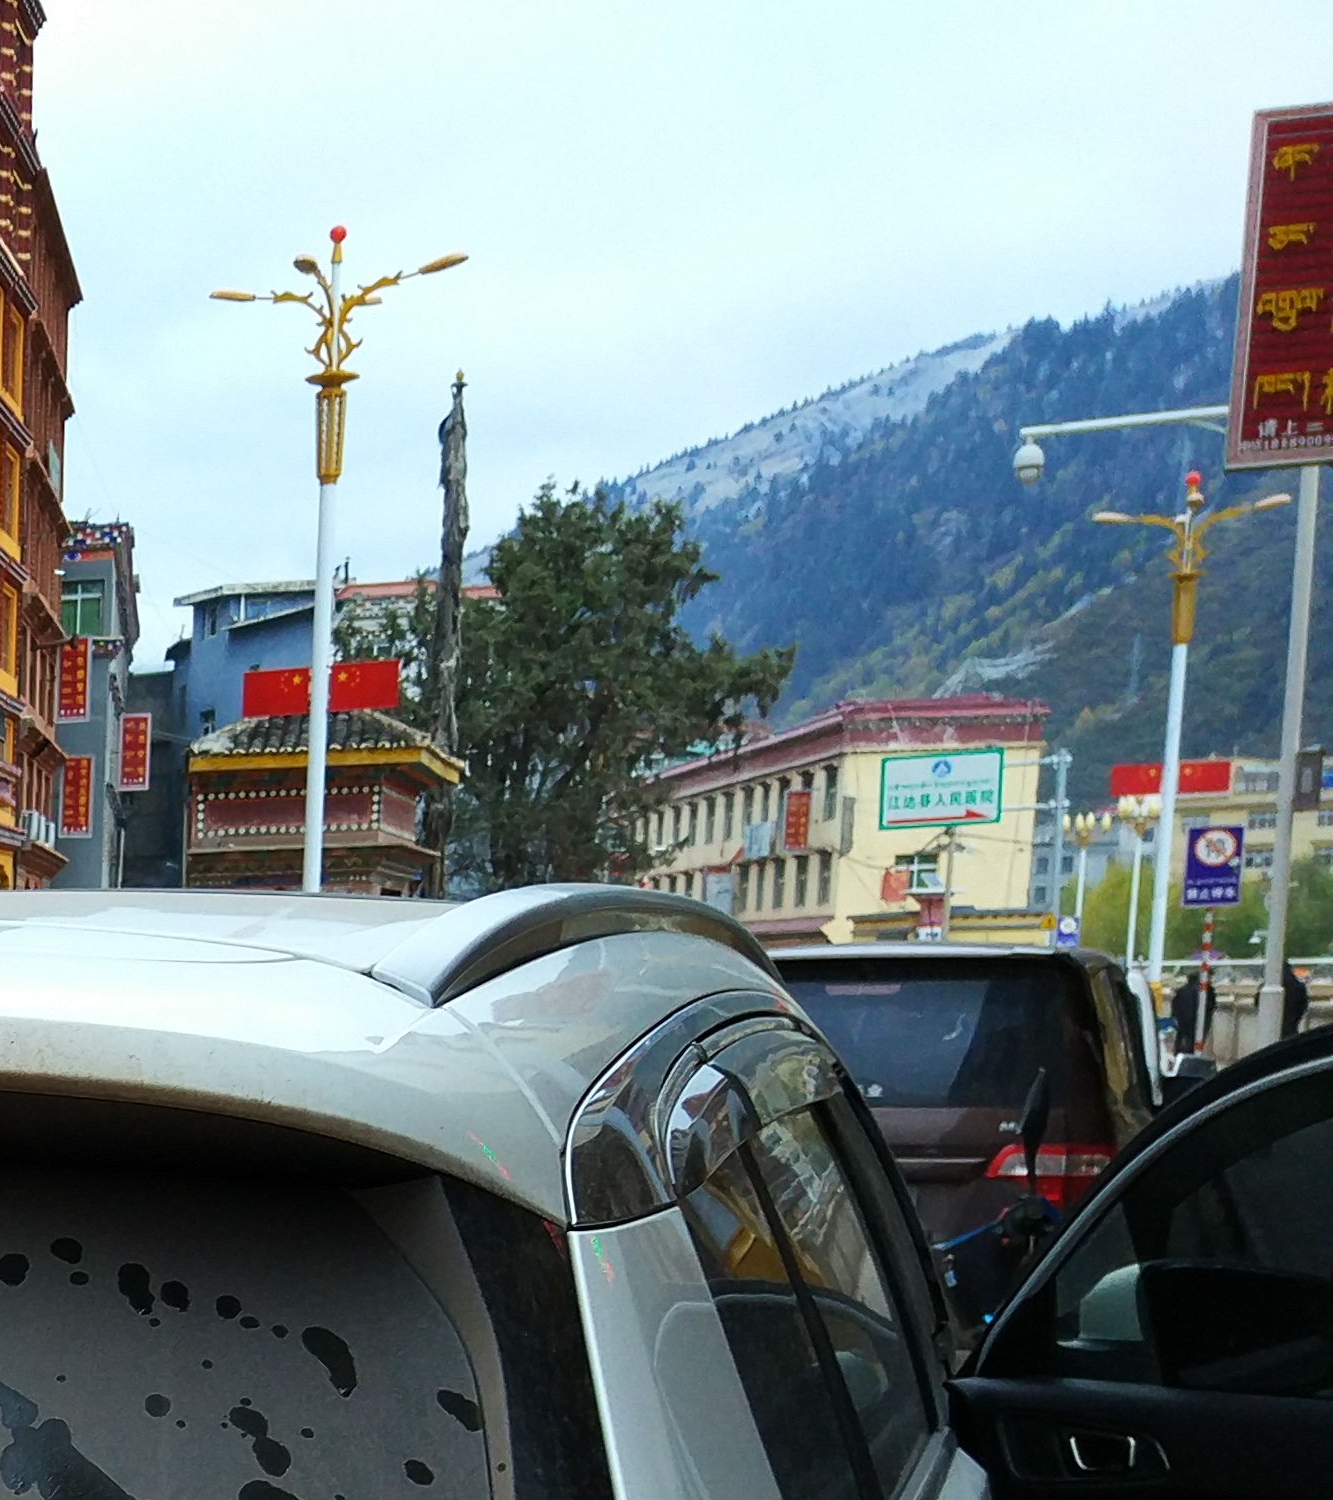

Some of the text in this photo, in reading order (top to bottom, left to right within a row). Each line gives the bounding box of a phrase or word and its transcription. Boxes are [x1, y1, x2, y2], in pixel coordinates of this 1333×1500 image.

[889, 789, 995, 810] 江达县人民医院
